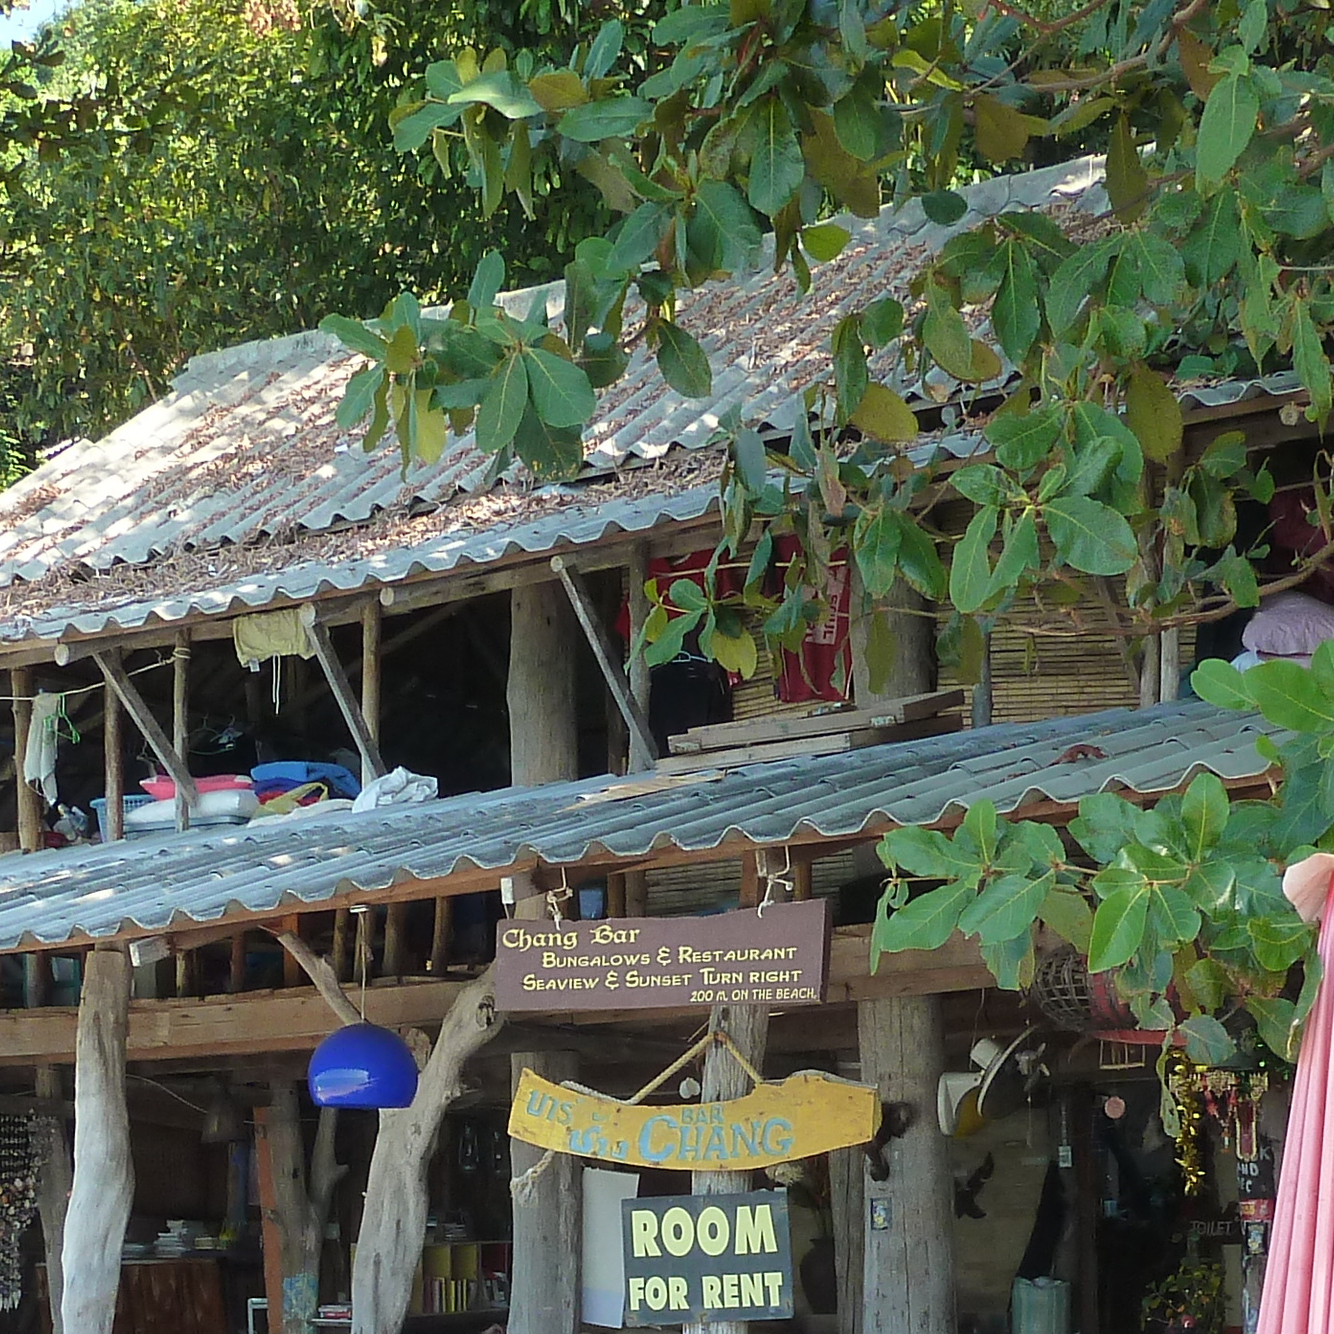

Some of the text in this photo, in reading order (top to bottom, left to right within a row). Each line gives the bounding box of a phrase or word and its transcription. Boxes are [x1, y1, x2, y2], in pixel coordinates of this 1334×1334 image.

[502, 924, 640, 951] Chang Bar
[657, 946, 672, 966] &
[605, 970, 620, 990] &
[699, 967, 743, 986] TURN
[749, 970, 803, 985] RIGHT
[690, 990, 713, 1003] 200
[731, 989, 749, 1001] ON
[752, 988, 773, 1000] THE
[681, 1103, 724, 1125] BAR
[638, 1114, 795, 1162] CHANG
[631, 1204, 778, 1258] ROOM
[1189, 1220, 1233, 1237] TOILET
[629, 1272, 783, 1311] FOR RENT
